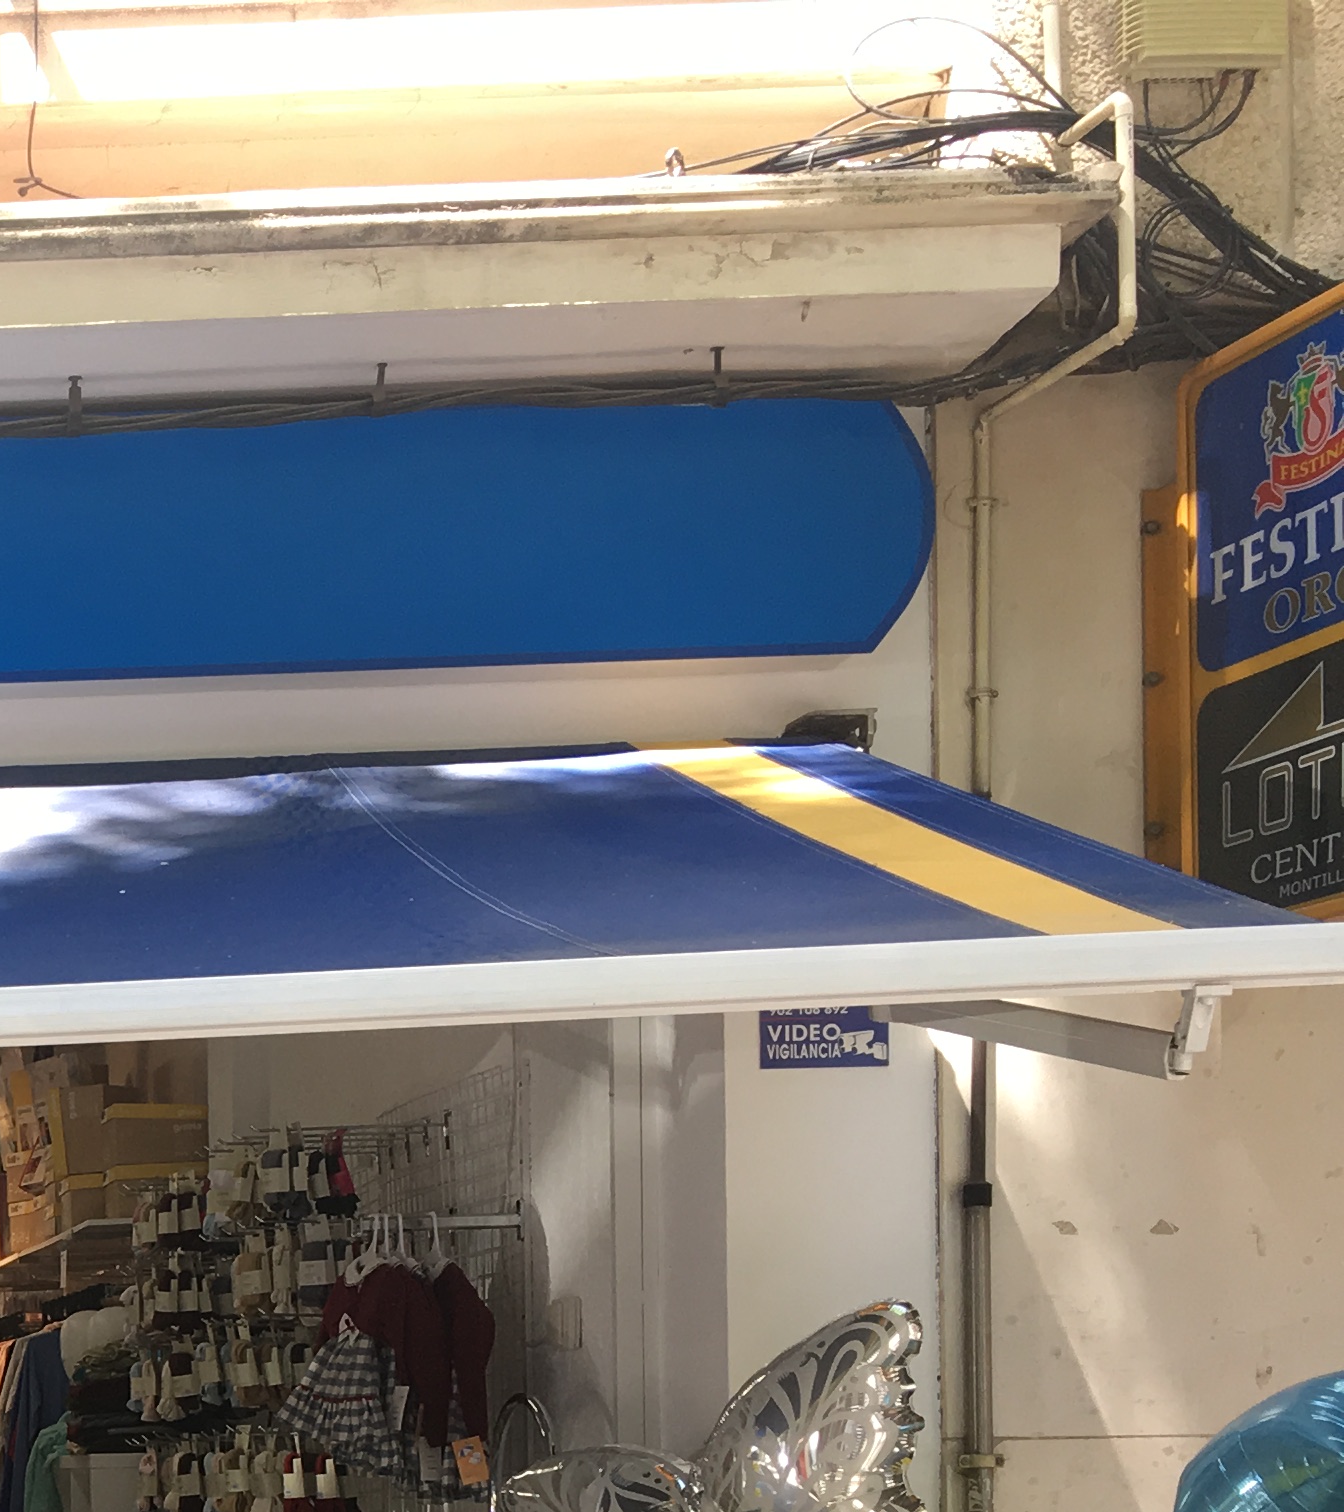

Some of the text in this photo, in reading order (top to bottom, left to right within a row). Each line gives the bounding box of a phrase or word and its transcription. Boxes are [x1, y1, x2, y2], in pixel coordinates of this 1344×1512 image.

[1264, 565, 1344, 633] OR
[1222, 742, 1344, 847] LOT
[767, 1023, 841, 1042] VIDEO
[767, 1043, 842, 1060] VIGILANCIA
